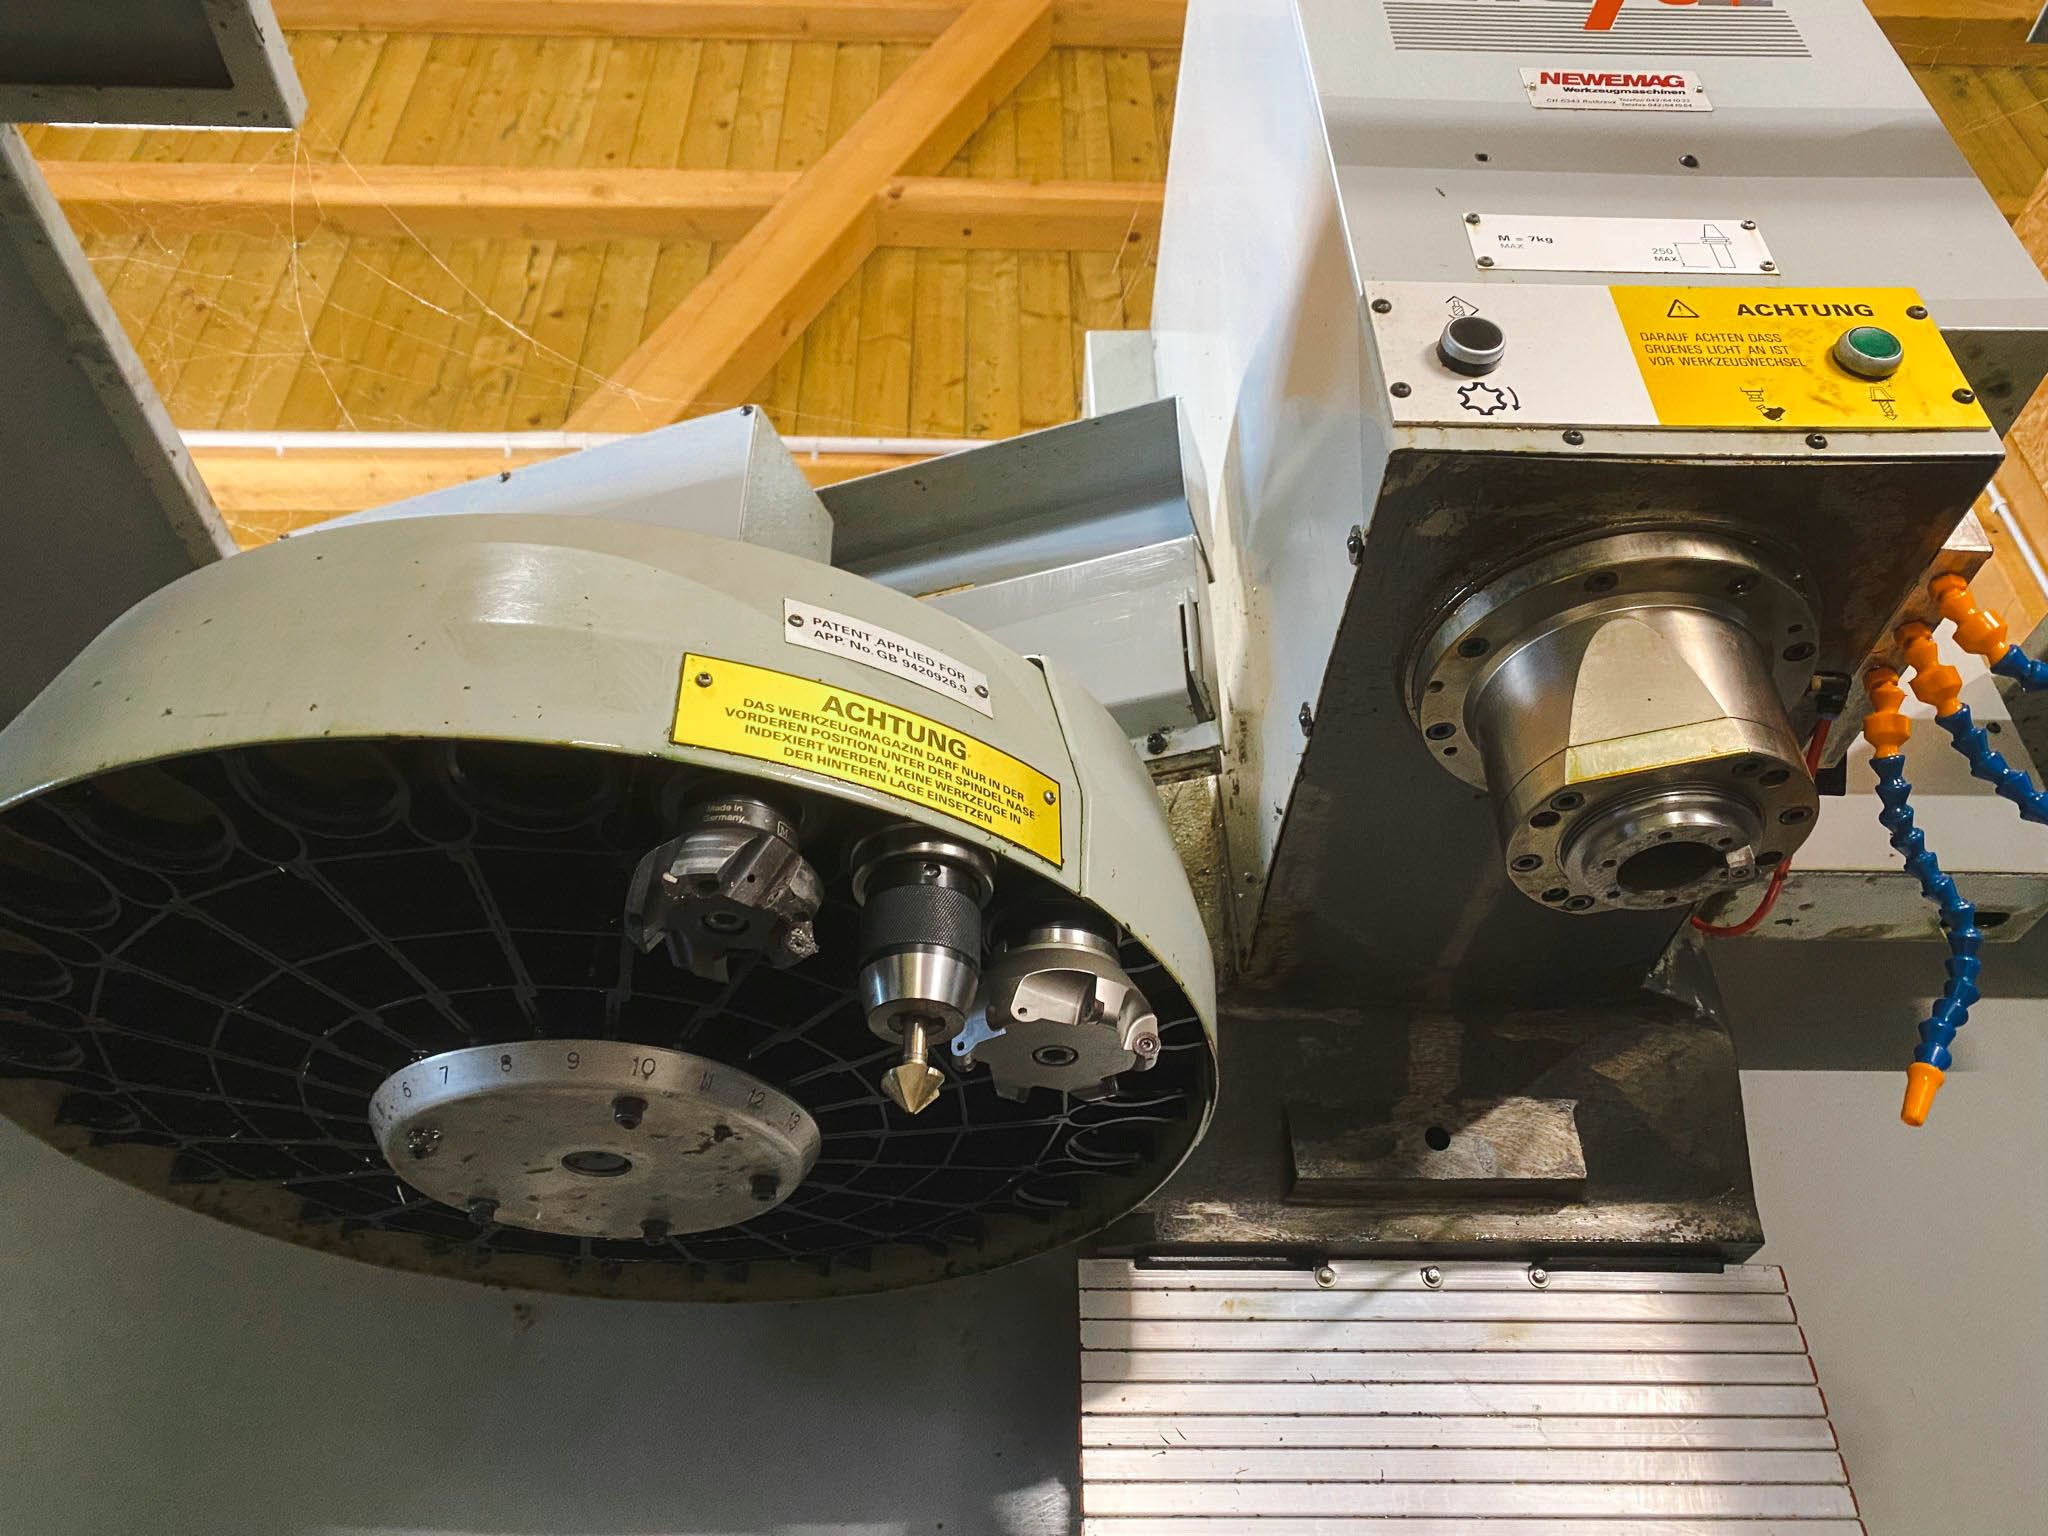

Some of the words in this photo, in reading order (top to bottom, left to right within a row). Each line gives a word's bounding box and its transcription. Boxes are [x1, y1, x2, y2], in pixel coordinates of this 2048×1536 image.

[1540, 72, 1685, 87] NEWEMAG
[1563, 86, 1686, 95] Werkzeugmaschinen
[1737, 304, 1875, 317] ACHTUNG
[1640, 332, 1690, 342] DARAUF
[1695, 332, 1744, 342] ACHTEN
[1749, 333, 1782, 342] DASS
[1644, 344, 1703, 354] GRUENES
[1706, 344, 1742, 354] LICHT
[1748, 345, 1765, 354] AN
[1770, 346, 1790, 355] IST
[1648, 356, 1674, 366] VOR
[1679, 356, 1807, 367] WERKZEUGWECHSEL
[812, 617, 872, 642] PATENT
[876, 638, 935, 667] APPLIED
[939, 663, 967, 682] FOR
[814, 630, 846, 646] APP.
[849, 640, 874, 656] No.
[876, 650, 898, 664] GB
[902, 658, 968, 694] 9420926.9
[821, 695, 968, 761] ACHTUNG
[743, 698, 776, 713] DAS
[778, 706, 923, 758] WERKZEUGMAGAZIN
[926, 752, 960, 771] DARF
[961, 766, 987, 784] NUR
[988, 778, 1001, 790] IN
[1002, 784, 1025, 803] DER
[724, 706, 808, 734] VORDEREN
[811, 728, 878, 755] POSITION
[881, 748, 926, 771] UNTER
[928, 764, 953, 782] DER
[956, 775, 1003, 805] SPINDEL
[1006, 798, 1036, 820] NASE
[744, 724, 825, 750] INDEXIERT
[828, 744, 890, 773] WERDEN,
[894, 766, 933, 787] KEINE
[935, 779, 1008, 818] WERKZEUGE
[1010, 812, 1022, 825] IN
[784, 747, 814, 762] DER
[816, 754, 886, 784] HINTEREN
[890, 777, 924, 796] LAGE
[927, 790, 993, 825] EINSETZEN
[500, 1054, 512, 1072] 8
[566, 1052, 580, 1070] 9
[632, 1056, 656, 1076] 10
[440, 1066, 448, 1084] 7
[402, 1081, 412, 1098] 6
[748, 1088, 766, 1108] 12
[786, 1111, 801, 1132] 13
